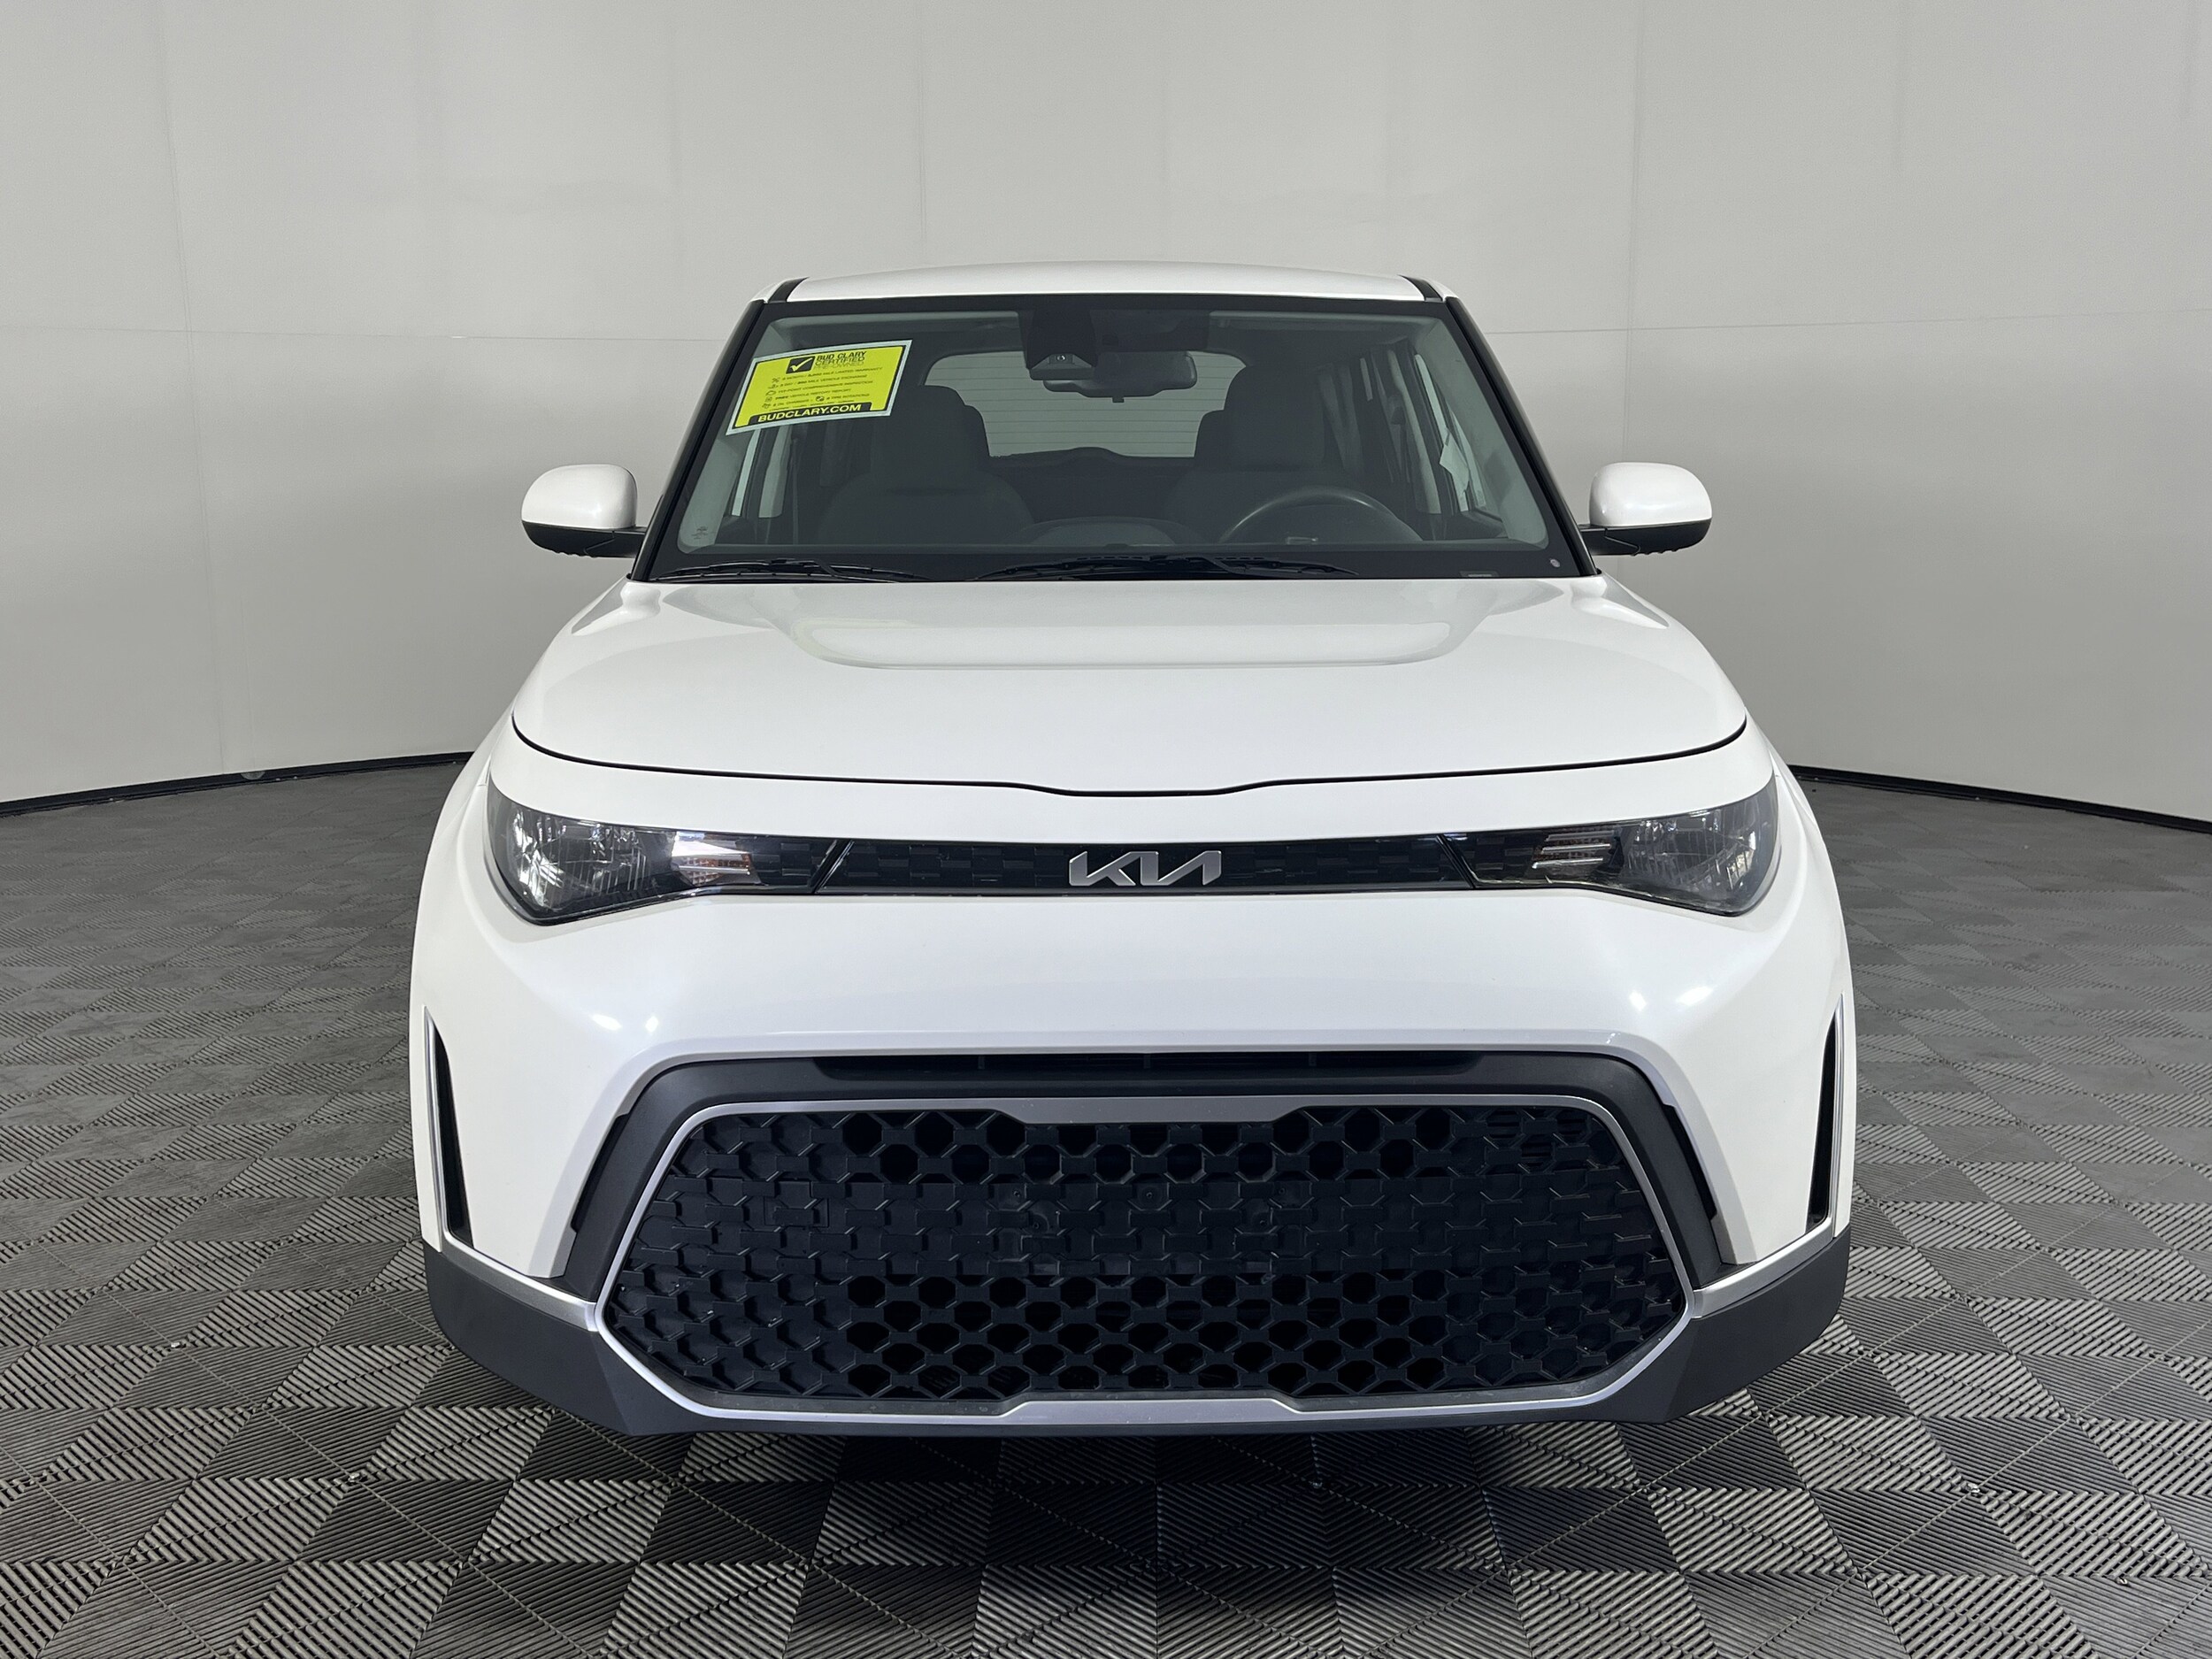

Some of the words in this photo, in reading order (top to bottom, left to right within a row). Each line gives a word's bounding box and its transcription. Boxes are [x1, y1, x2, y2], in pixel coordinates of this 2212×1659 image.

[815, 356, 865, 366] CERTIFIED
[757, 403, 862, 422] BUDCLARY.COM
[1069, 850, 1222, 887] KIA
